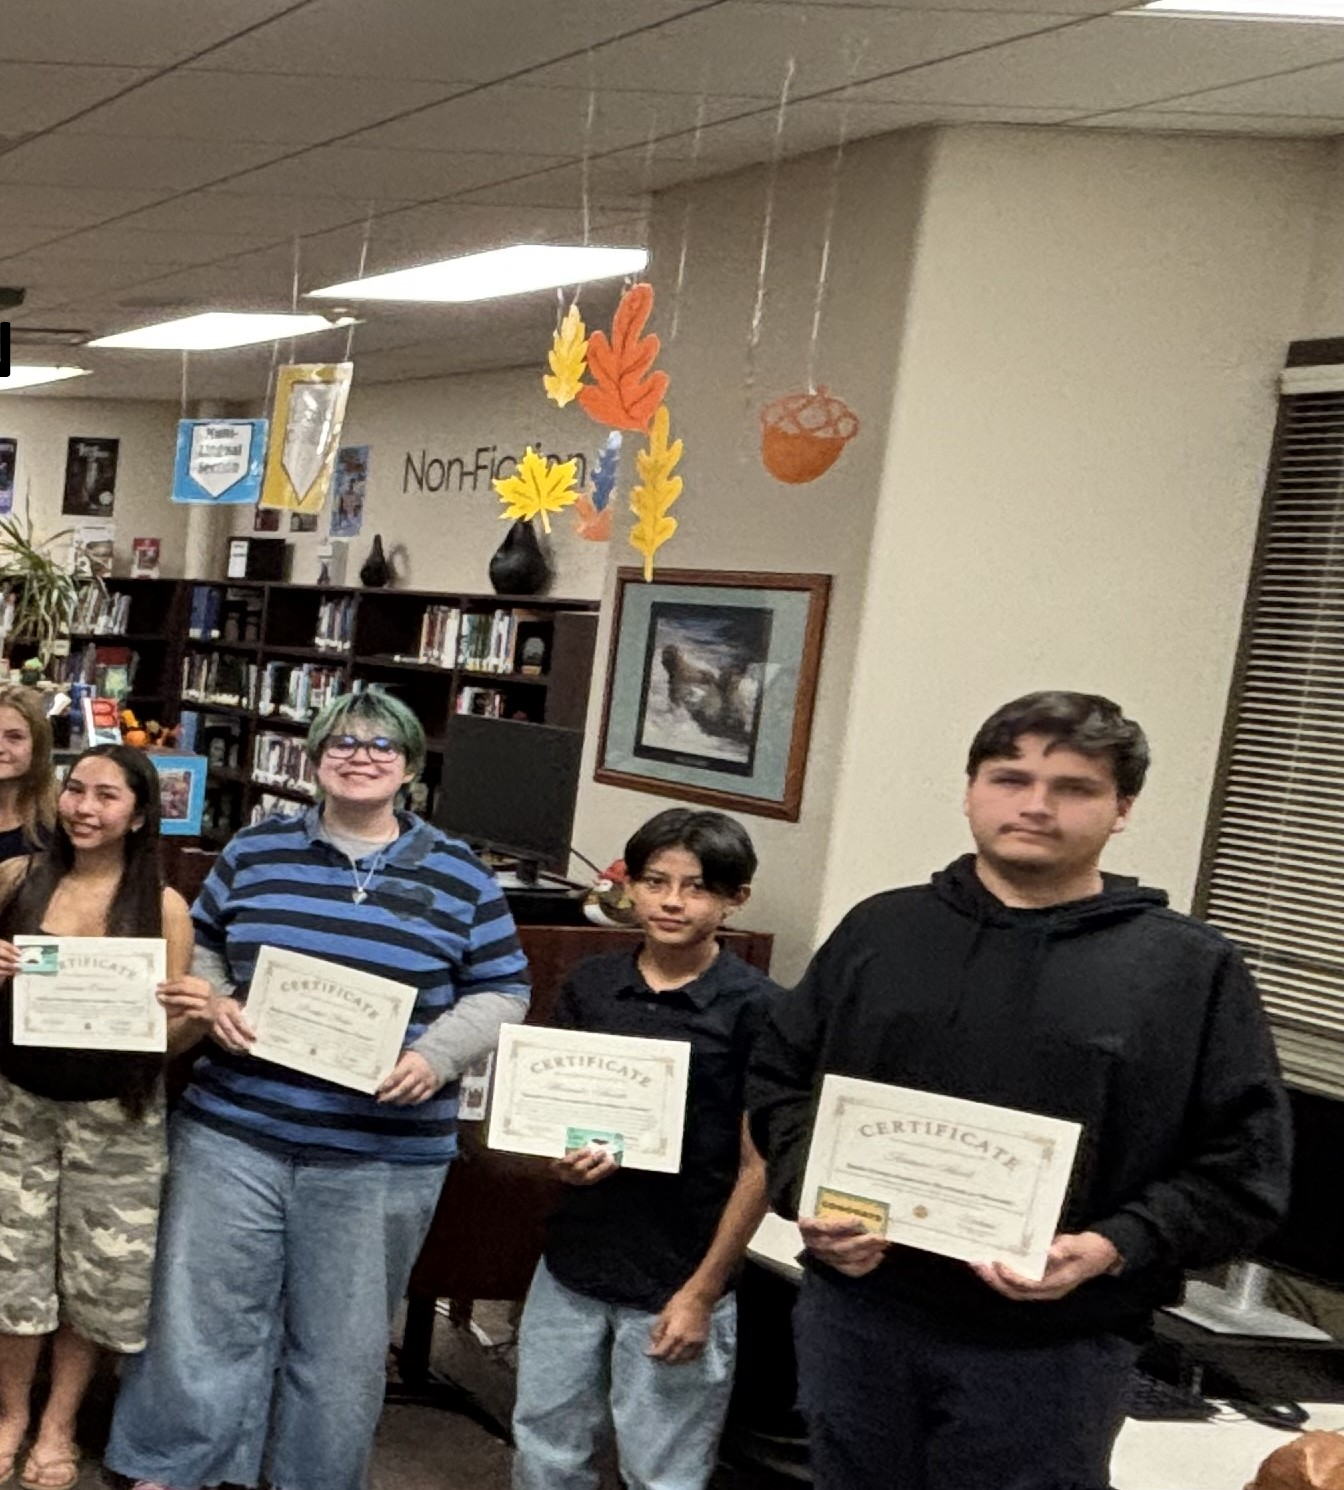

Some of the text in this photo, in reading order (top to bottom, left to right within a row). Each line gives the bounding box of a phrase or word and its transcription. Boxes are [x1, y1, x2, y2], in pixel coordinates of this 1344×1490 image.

[403, 442, 587, 493] Non-Ficn
[58, 956, 138, 980] RTIFICATE
[280, 979, 380, 1020] CERTIFICATE
[530, 1055, 653, 1089] CERTIFICATE
[858, 1118, 1024, 1173] CERTIFICATE
